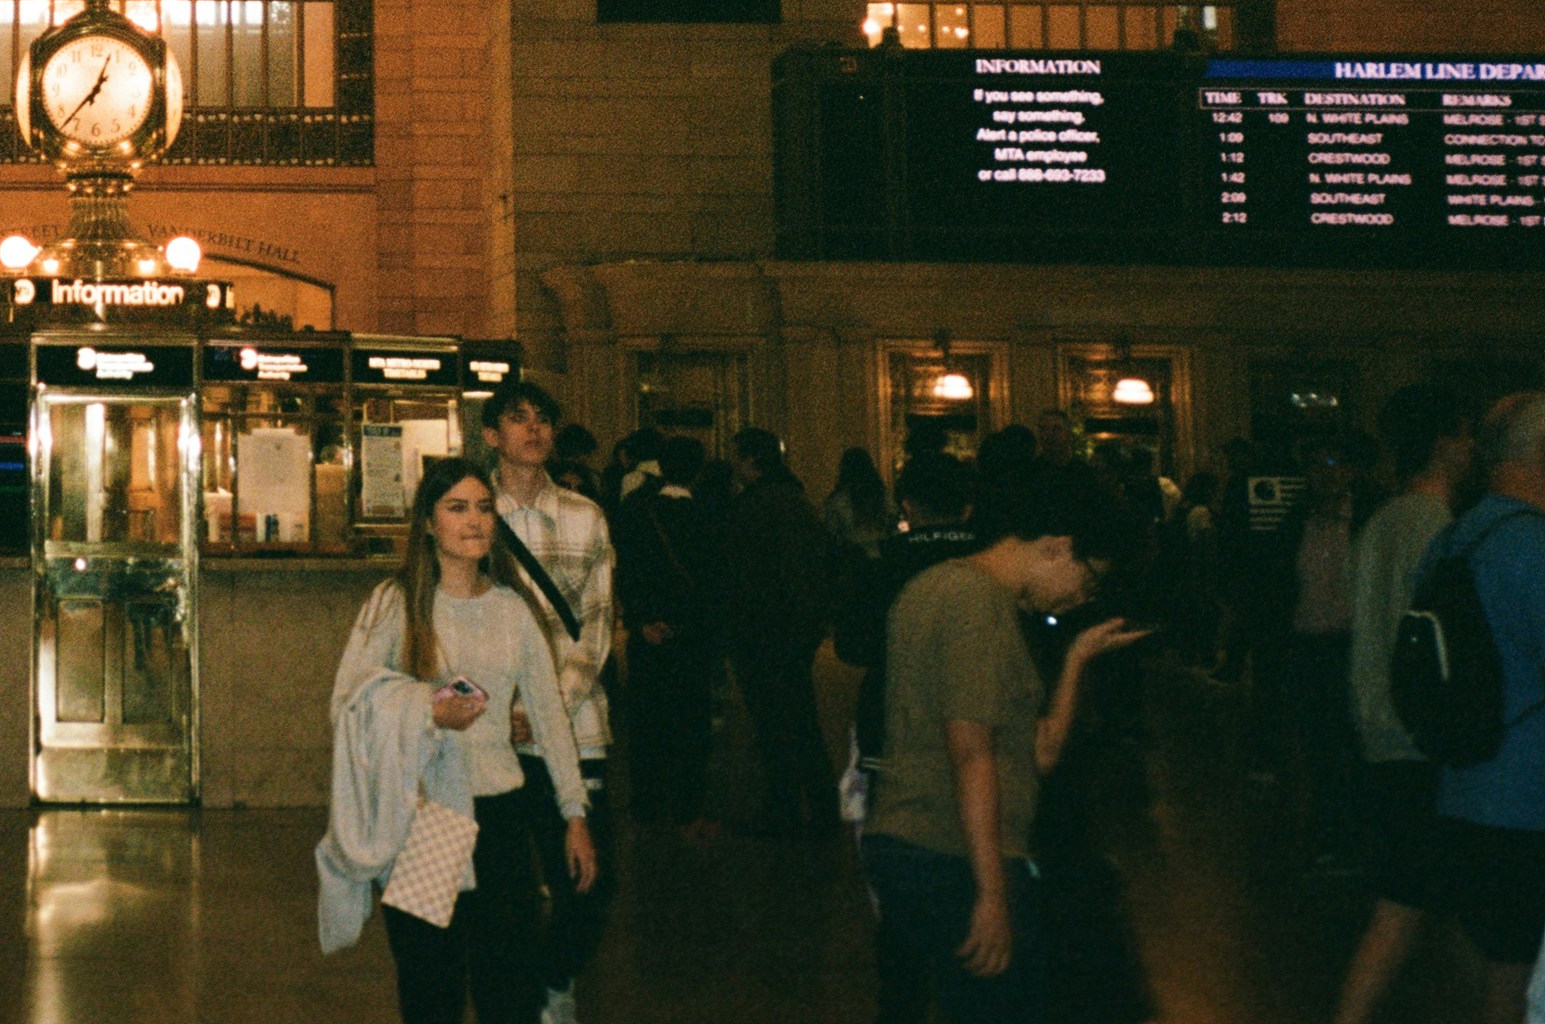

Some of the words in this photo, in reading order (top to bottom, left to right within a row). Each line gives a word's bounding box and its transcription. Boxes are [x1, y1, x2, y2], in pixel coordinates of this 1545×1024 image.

[976, 60, 1100, 73] INFORMATION
[1335, 63, 1421, 79] HARLEM
[1426, 64, 1475, 79] LINE
[974, 89, 983, 100] If
[985, 91, 1009, 103] you
[1010, 92, 1034, 101] see
[1205, 92, 1241, 104] TIME
[1304, 93, 1405, 105] DESTINATION
[1443, 94, 1511, 106] REMARKS
[993, 111, 1015, 123] say
[1322, 113, 1362, 124] WHITE
[1364, 113, 1408, 124] PLAINS
[1444, 114, 1503, 125] MELROSE
[977, 128, 1006, 140] Alert
[1008, 131, 1017, 141] a
[1019, 129, 1057, 142] police
[1308, 133, 1382, 144] SOUTHEAST
[1445, 134, 1527, 145] CONNECTION
[995, 148, 1025, 160] MTA
[1026, 150, 1087, 163] employee
[1308, 153, 1390, 164] CRESTWOOD
[1445, 154, 1504, 165] MELROSE
[978, 170, 992, 180] or
[994, 169, 1018, 180] call
[1325, 173, 1364, 184] WHITE
[1368, 173, 1411, 184] PLAINS
[1447, 174, 1506, 185] MELROSE
[1311, 193, 1385, 204] SOUTHEAST
[1311, 213, 1393, 224] CRESTWOOD
[147, 223, 255, 253] VANDERBILT
[257, 240, 301, 264] HALL
[52, 279, 184, 306] Information
